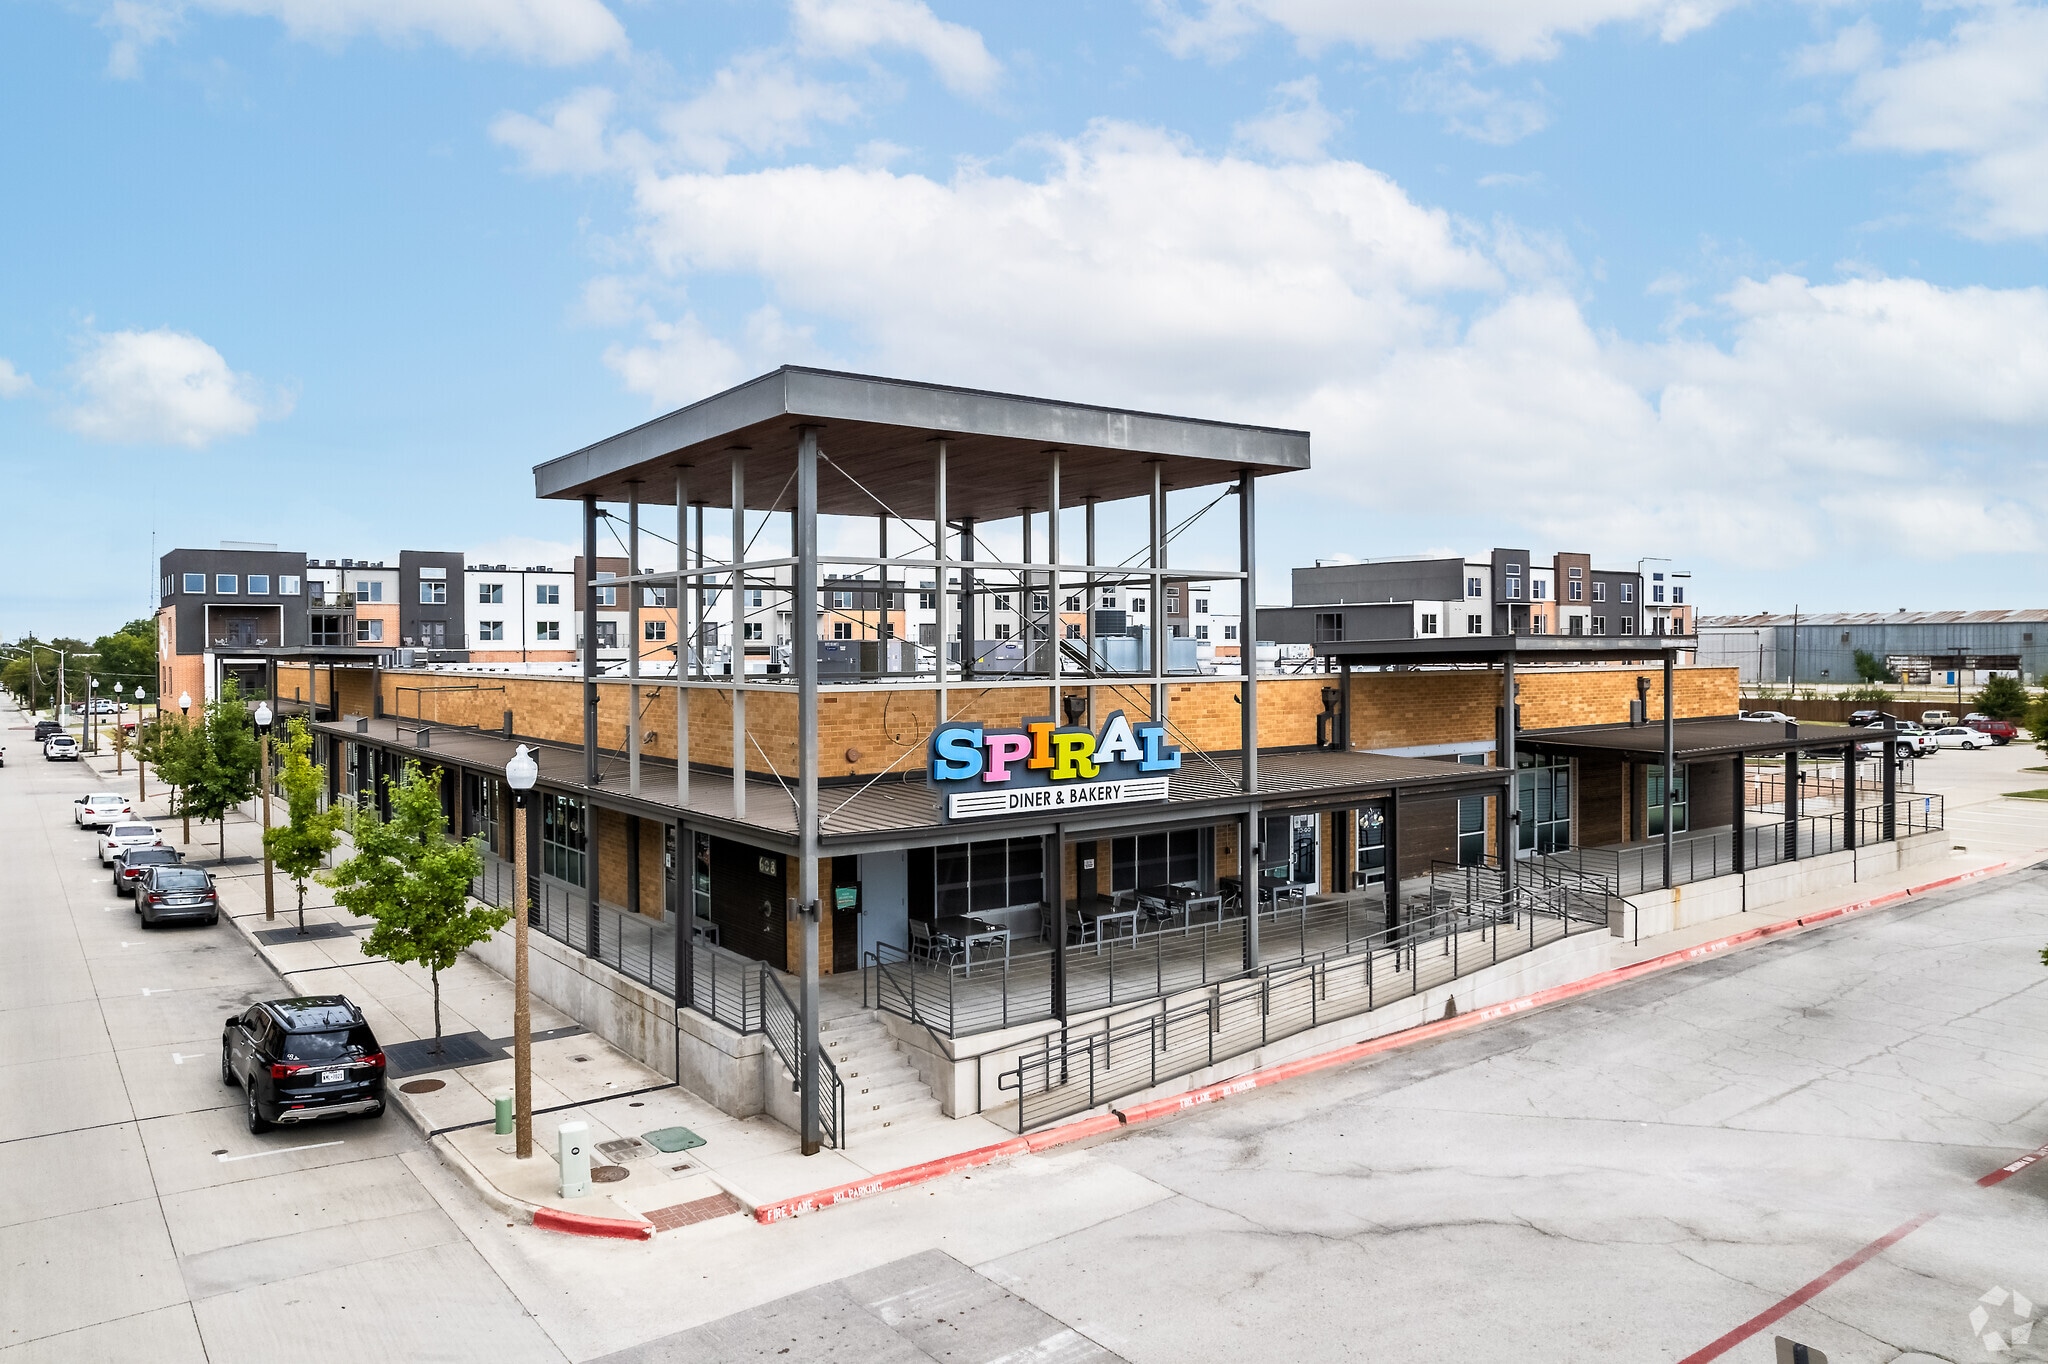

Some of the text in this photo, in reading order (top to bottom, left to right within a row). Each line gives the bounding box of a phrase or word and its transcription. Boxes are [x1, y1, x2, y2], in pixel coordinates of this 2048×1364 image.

[934, 715, 1181, 782] SPIRAL
[1009, 785, 1121, 809] DINER & BAKERY
[759, 856, 776, 875] 608
[767, 1182, 883, 1221] FIRE LANE NO PARKING
